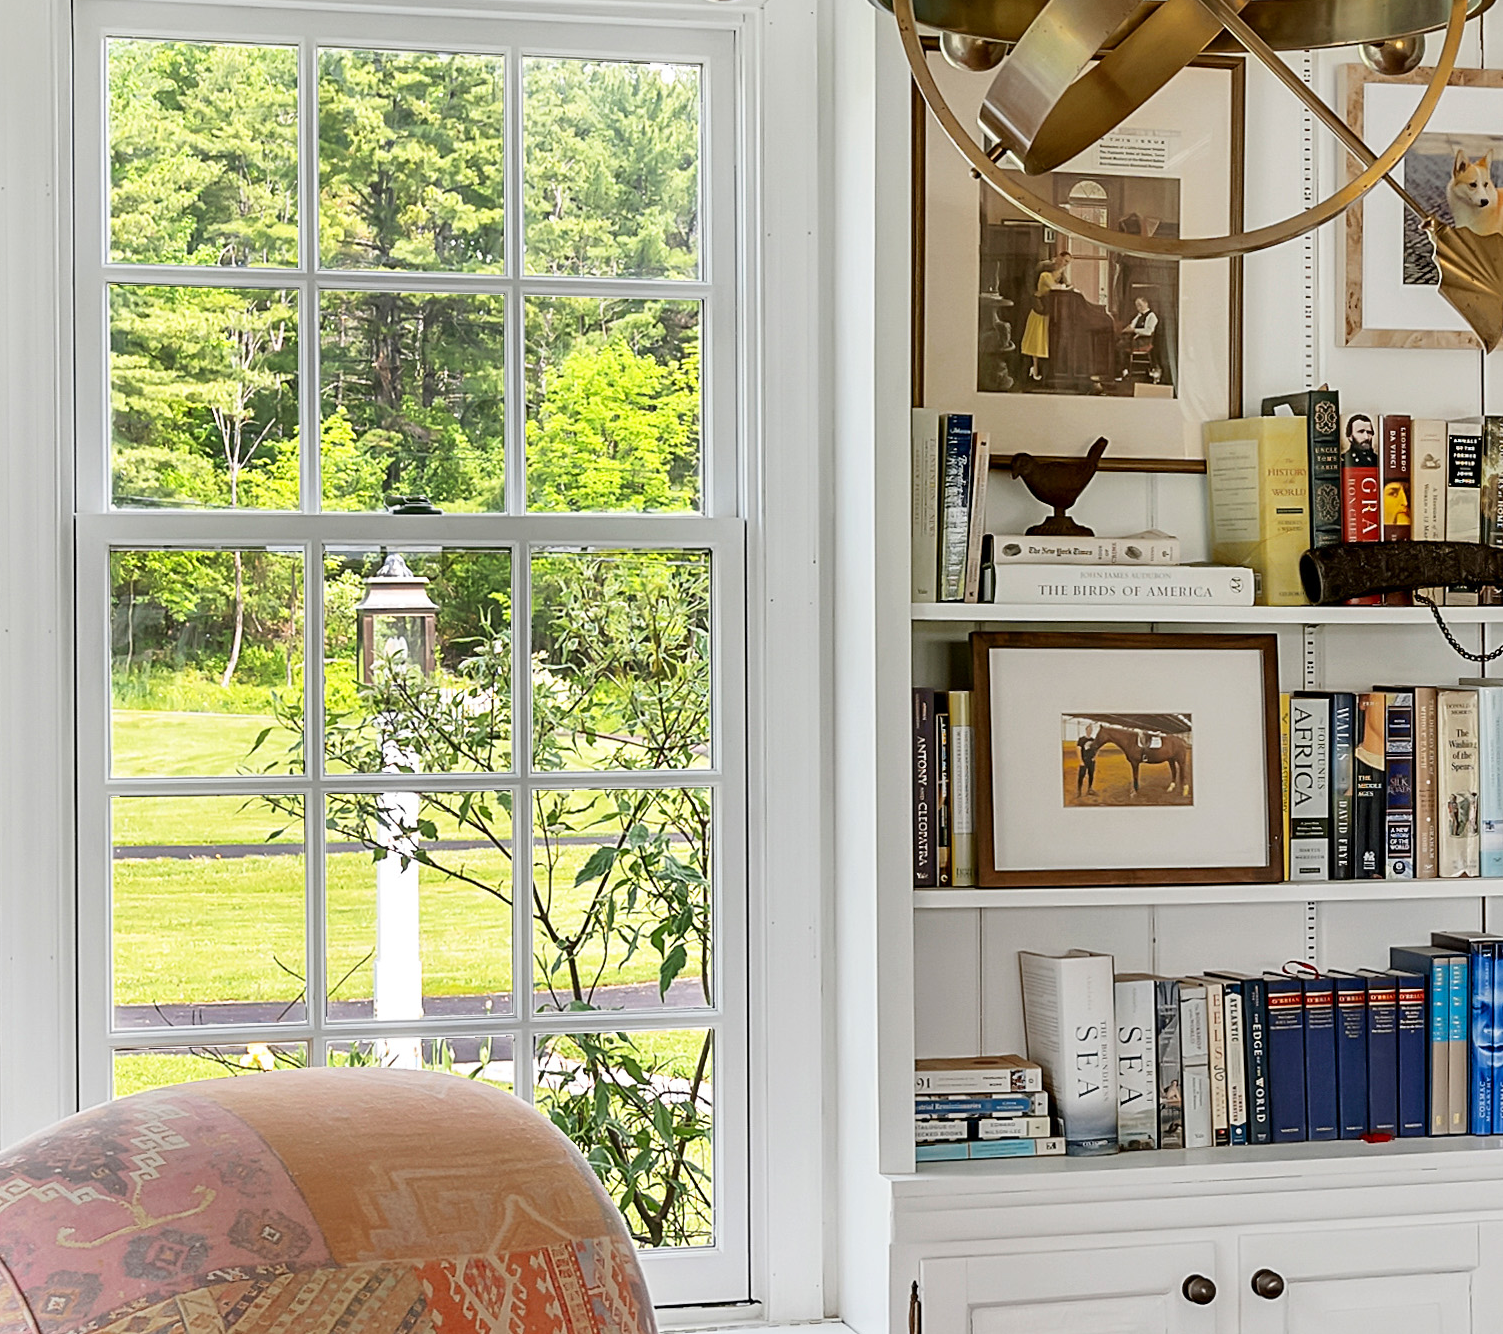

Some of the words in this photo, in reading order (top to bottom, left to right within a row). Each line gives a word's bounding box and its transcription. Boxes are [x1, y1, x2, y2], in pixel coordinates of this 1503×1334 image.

[1389, 430, 1396, 441] DA
[1267, 468, 1306, 476] HISTORY
[1271, 488, 1306, 496] WORLD
[1028, 546, 1041, 555] The
[1041, 547, 1056, 556] New
[1056, 548, 1072, 556] York
[1073, 547, 1093, 556] Times
[1038, 584, 1068, 596] THE
[1073, 585, 1116, 596] BIRDS
[1122, 585, 1142, 596] OF
[1146, 586, 1213, 597] AMERICA
[1337, 707, 1350, 760] WALLS
[1448, 740, 1477, 749] Washing
[1455, 729, 1469, 737] The
[917, 736, 928, 786] ANTONY
[1294, 707, 1313, 807] AFRICA
[1317, 727, 1325, 790] FORTUNES
[1451, 763, 1474, 772] Spears
[1452, 751, 1460, 759] of
[1461, 751, 1472, 759] the
[918, 802, 928, 866] CLEOPATRA
[1338, 800, 1348, 833] DAVID
[1338, 838, 1348, 866] FRYE
[1213, 994, 1222, 1058] EELS
[1230, 998, 1239, 1042] ATLANTIC
[1252, 1023, 1263, 1056] EDGE
[1075, 1025, 1100, 1099] SEA
[1101, 1043, 1109, 1102] BOUNDLESS
[1118, 1026, 1144, 1108] SEA
[1145, 1060, 1153, 1104] GREAT
[1255, 1077, 1266, 1122] WORLD
